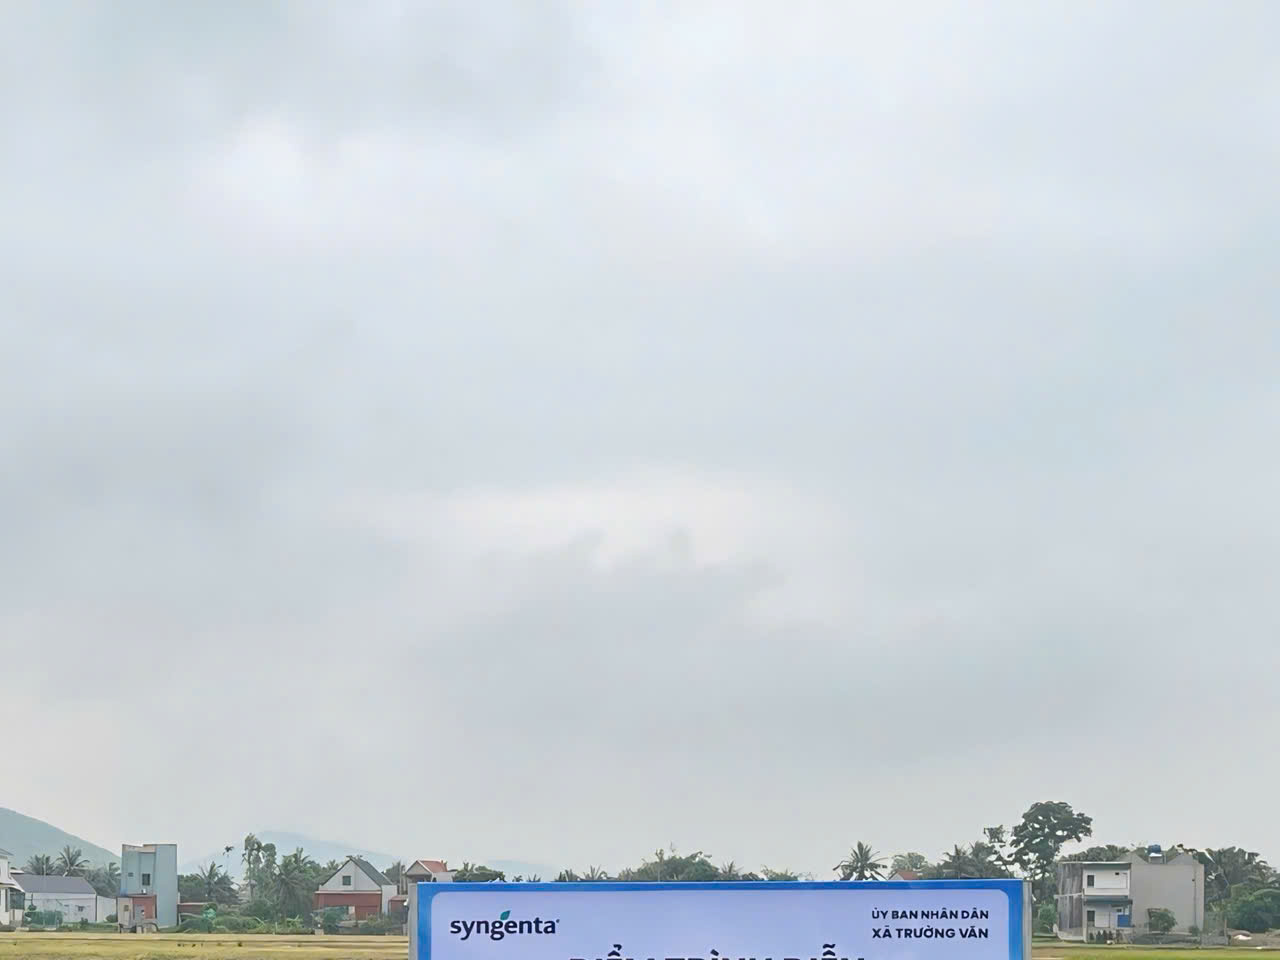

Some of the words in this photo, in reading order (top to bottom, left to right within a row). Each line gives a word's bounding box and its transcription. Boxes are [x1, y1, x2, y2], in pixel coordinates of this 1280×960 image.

[891, 910, 918, 919] BAN
[921, 907, 958, 919] NHÂN
[961, 907, 989, 919] DÂN
[450, 917, 556, 940] syngenta
[872, 925, 892, 939] XÃ
[896, 925, 956, 939] TRƯỜNG
